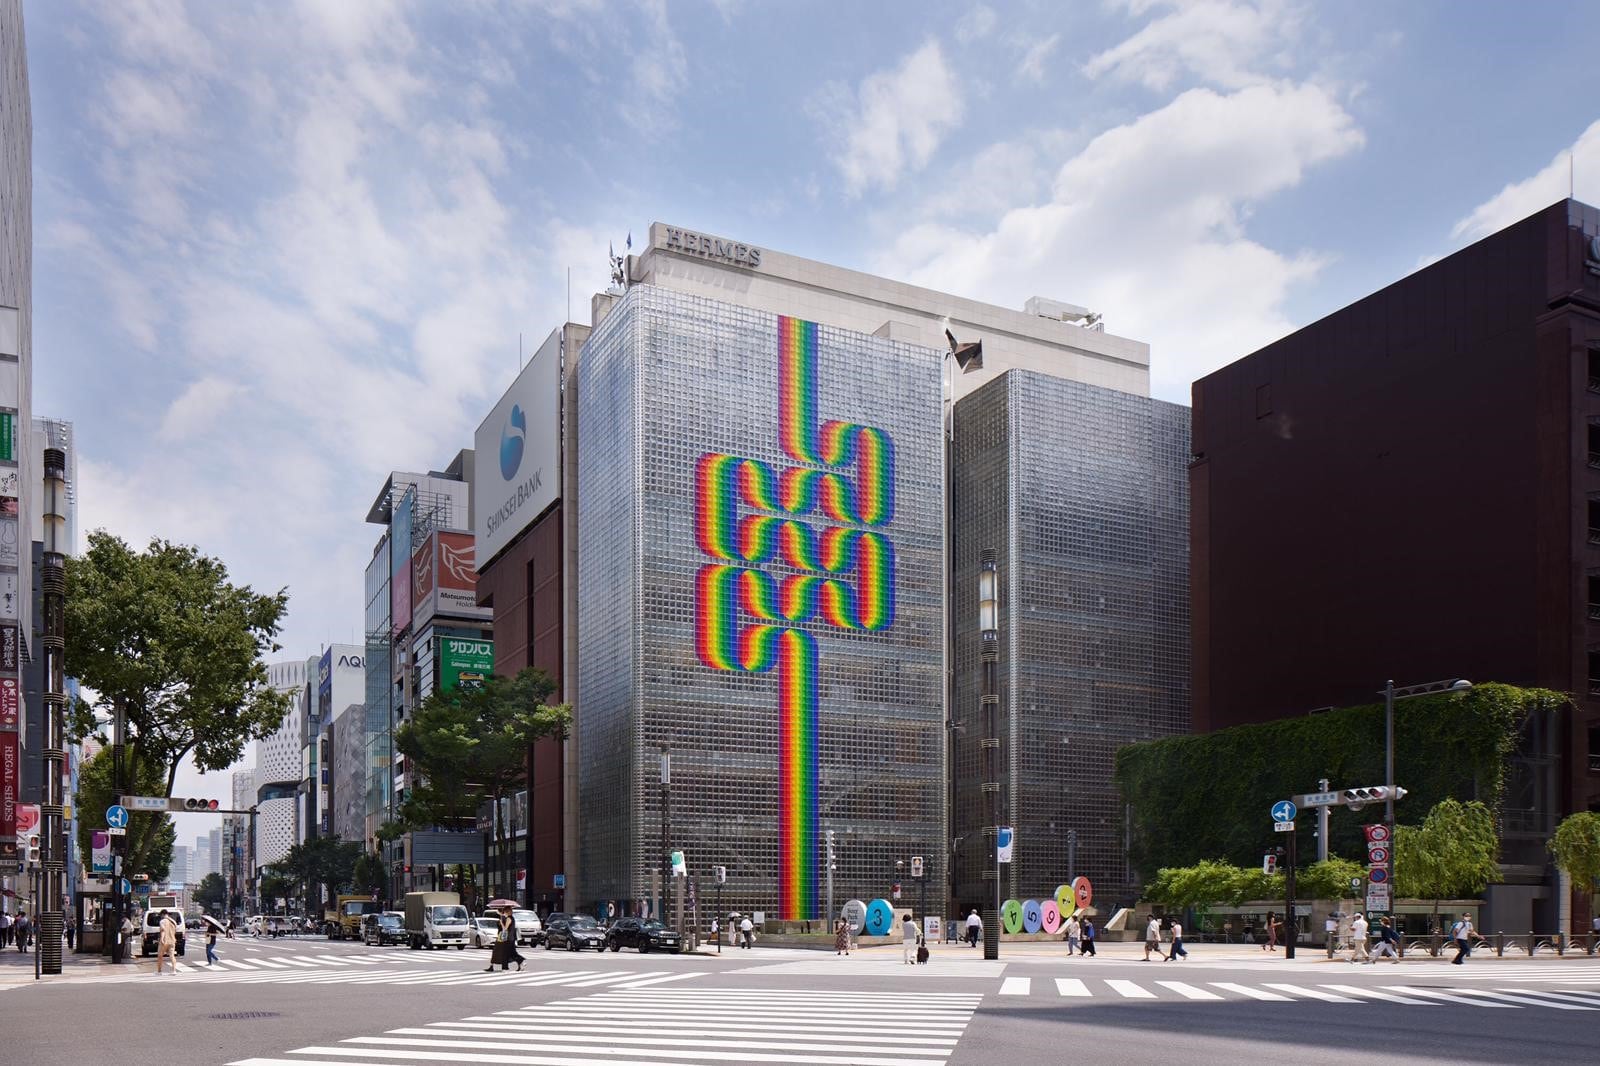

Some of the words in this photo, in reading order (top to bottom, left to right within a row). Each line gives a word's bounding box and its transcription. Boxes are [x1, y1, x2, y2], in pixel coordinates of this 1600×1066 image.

[486, 494, 517, 538] SHINSEI
[517, 467, 542, 508] BANK
[449, 641, 492, 655] サロンパス
[8, 688, 16, 715] 不二家
[5, 745, 13, 782] REGAL
[5, 785, 13, 822] SHOES
[873, 909, 882, 927] 3
